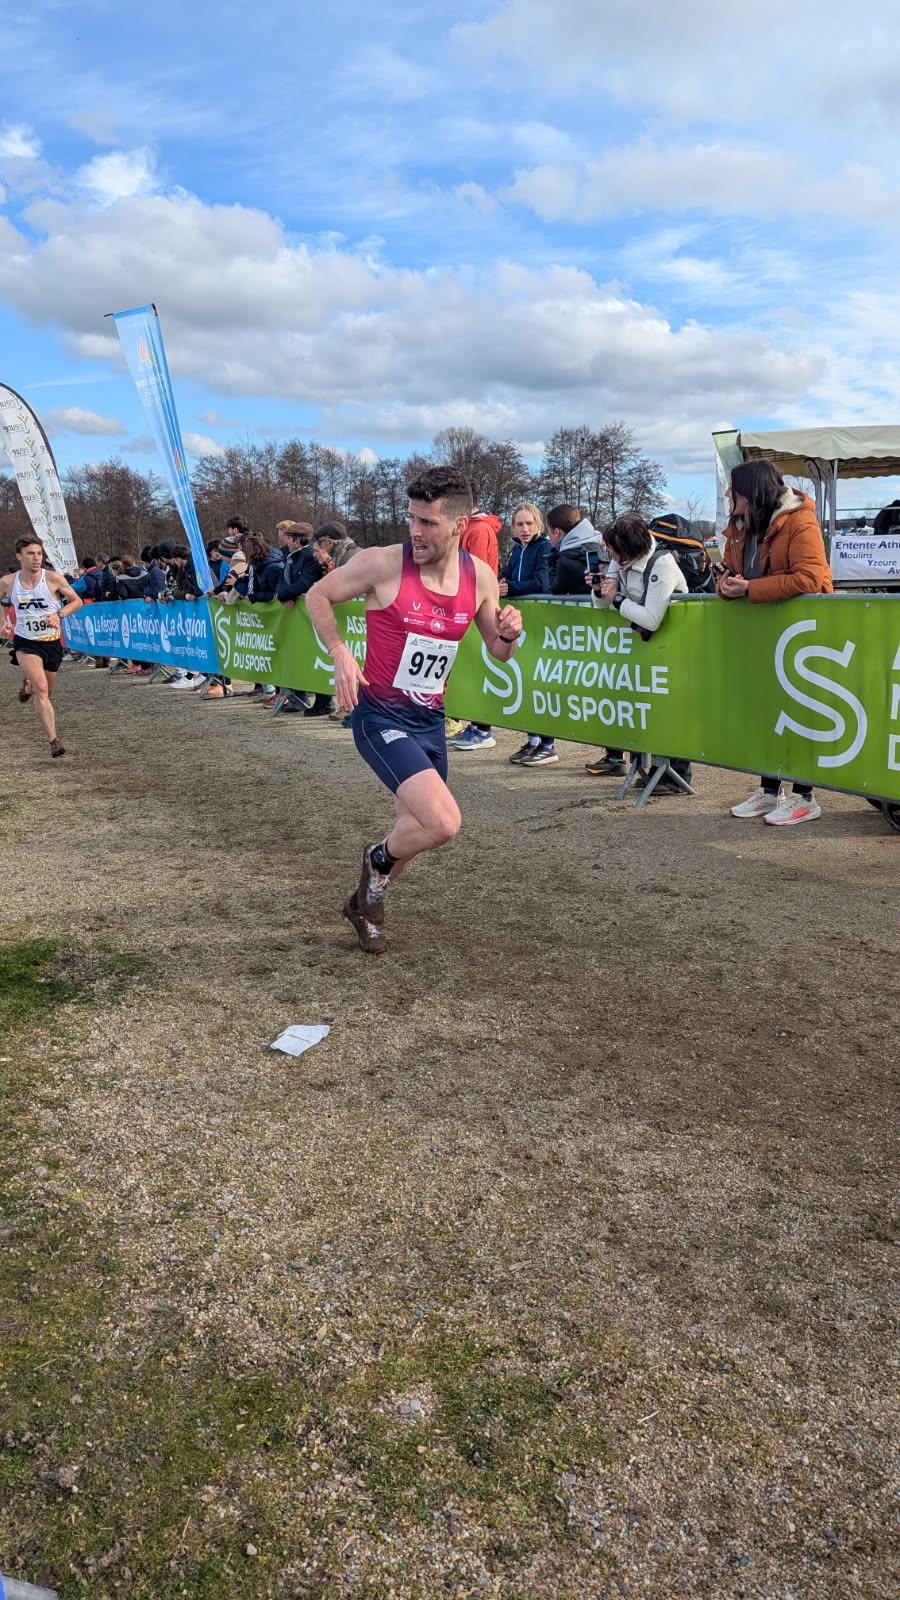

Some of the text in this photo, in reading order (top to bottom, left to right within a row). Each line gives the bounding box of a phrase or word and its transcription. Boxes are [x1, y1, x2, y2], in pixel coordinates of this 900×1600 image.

[835, 541, 876, 550] Entente
[839, 551, 873, 559] Moulins
[867, 559, 897, 567] Yzeure
[235, 611, 264, 629] AGENCE
[346, 615, 367, 634] AGE
[234, 631, 277, 652] NATIONALE
[542, 625, 633, 655] AGENCE
[233, 652, 272, 673] DU SPORT
[408, 651, 449, 680] 973
[533, 657, 670, 695] NATIONALE
[532, 690, 652, 730] DU SPORT
